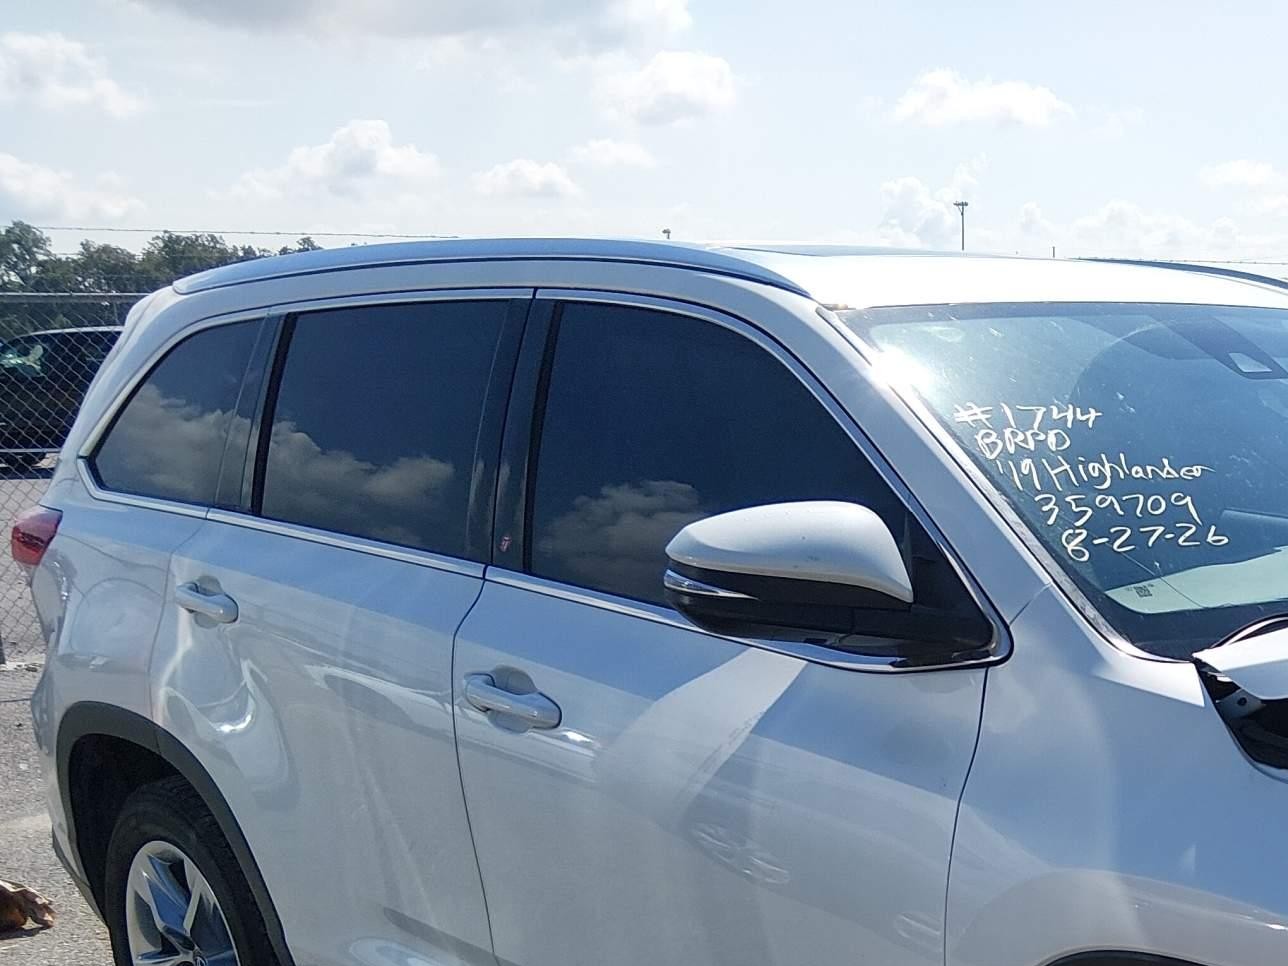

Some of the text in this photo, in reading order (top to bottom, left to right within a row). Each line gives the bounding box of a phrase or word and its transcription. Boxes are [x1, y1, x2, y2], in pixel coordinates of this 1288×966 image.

[954, 402, 1102, 429] #1744
[1042, 453, 1215, 491] Highlander
[1034, 492, 1203, 527] 359709
[1061, 523, 1230, 561] 8-27-26
